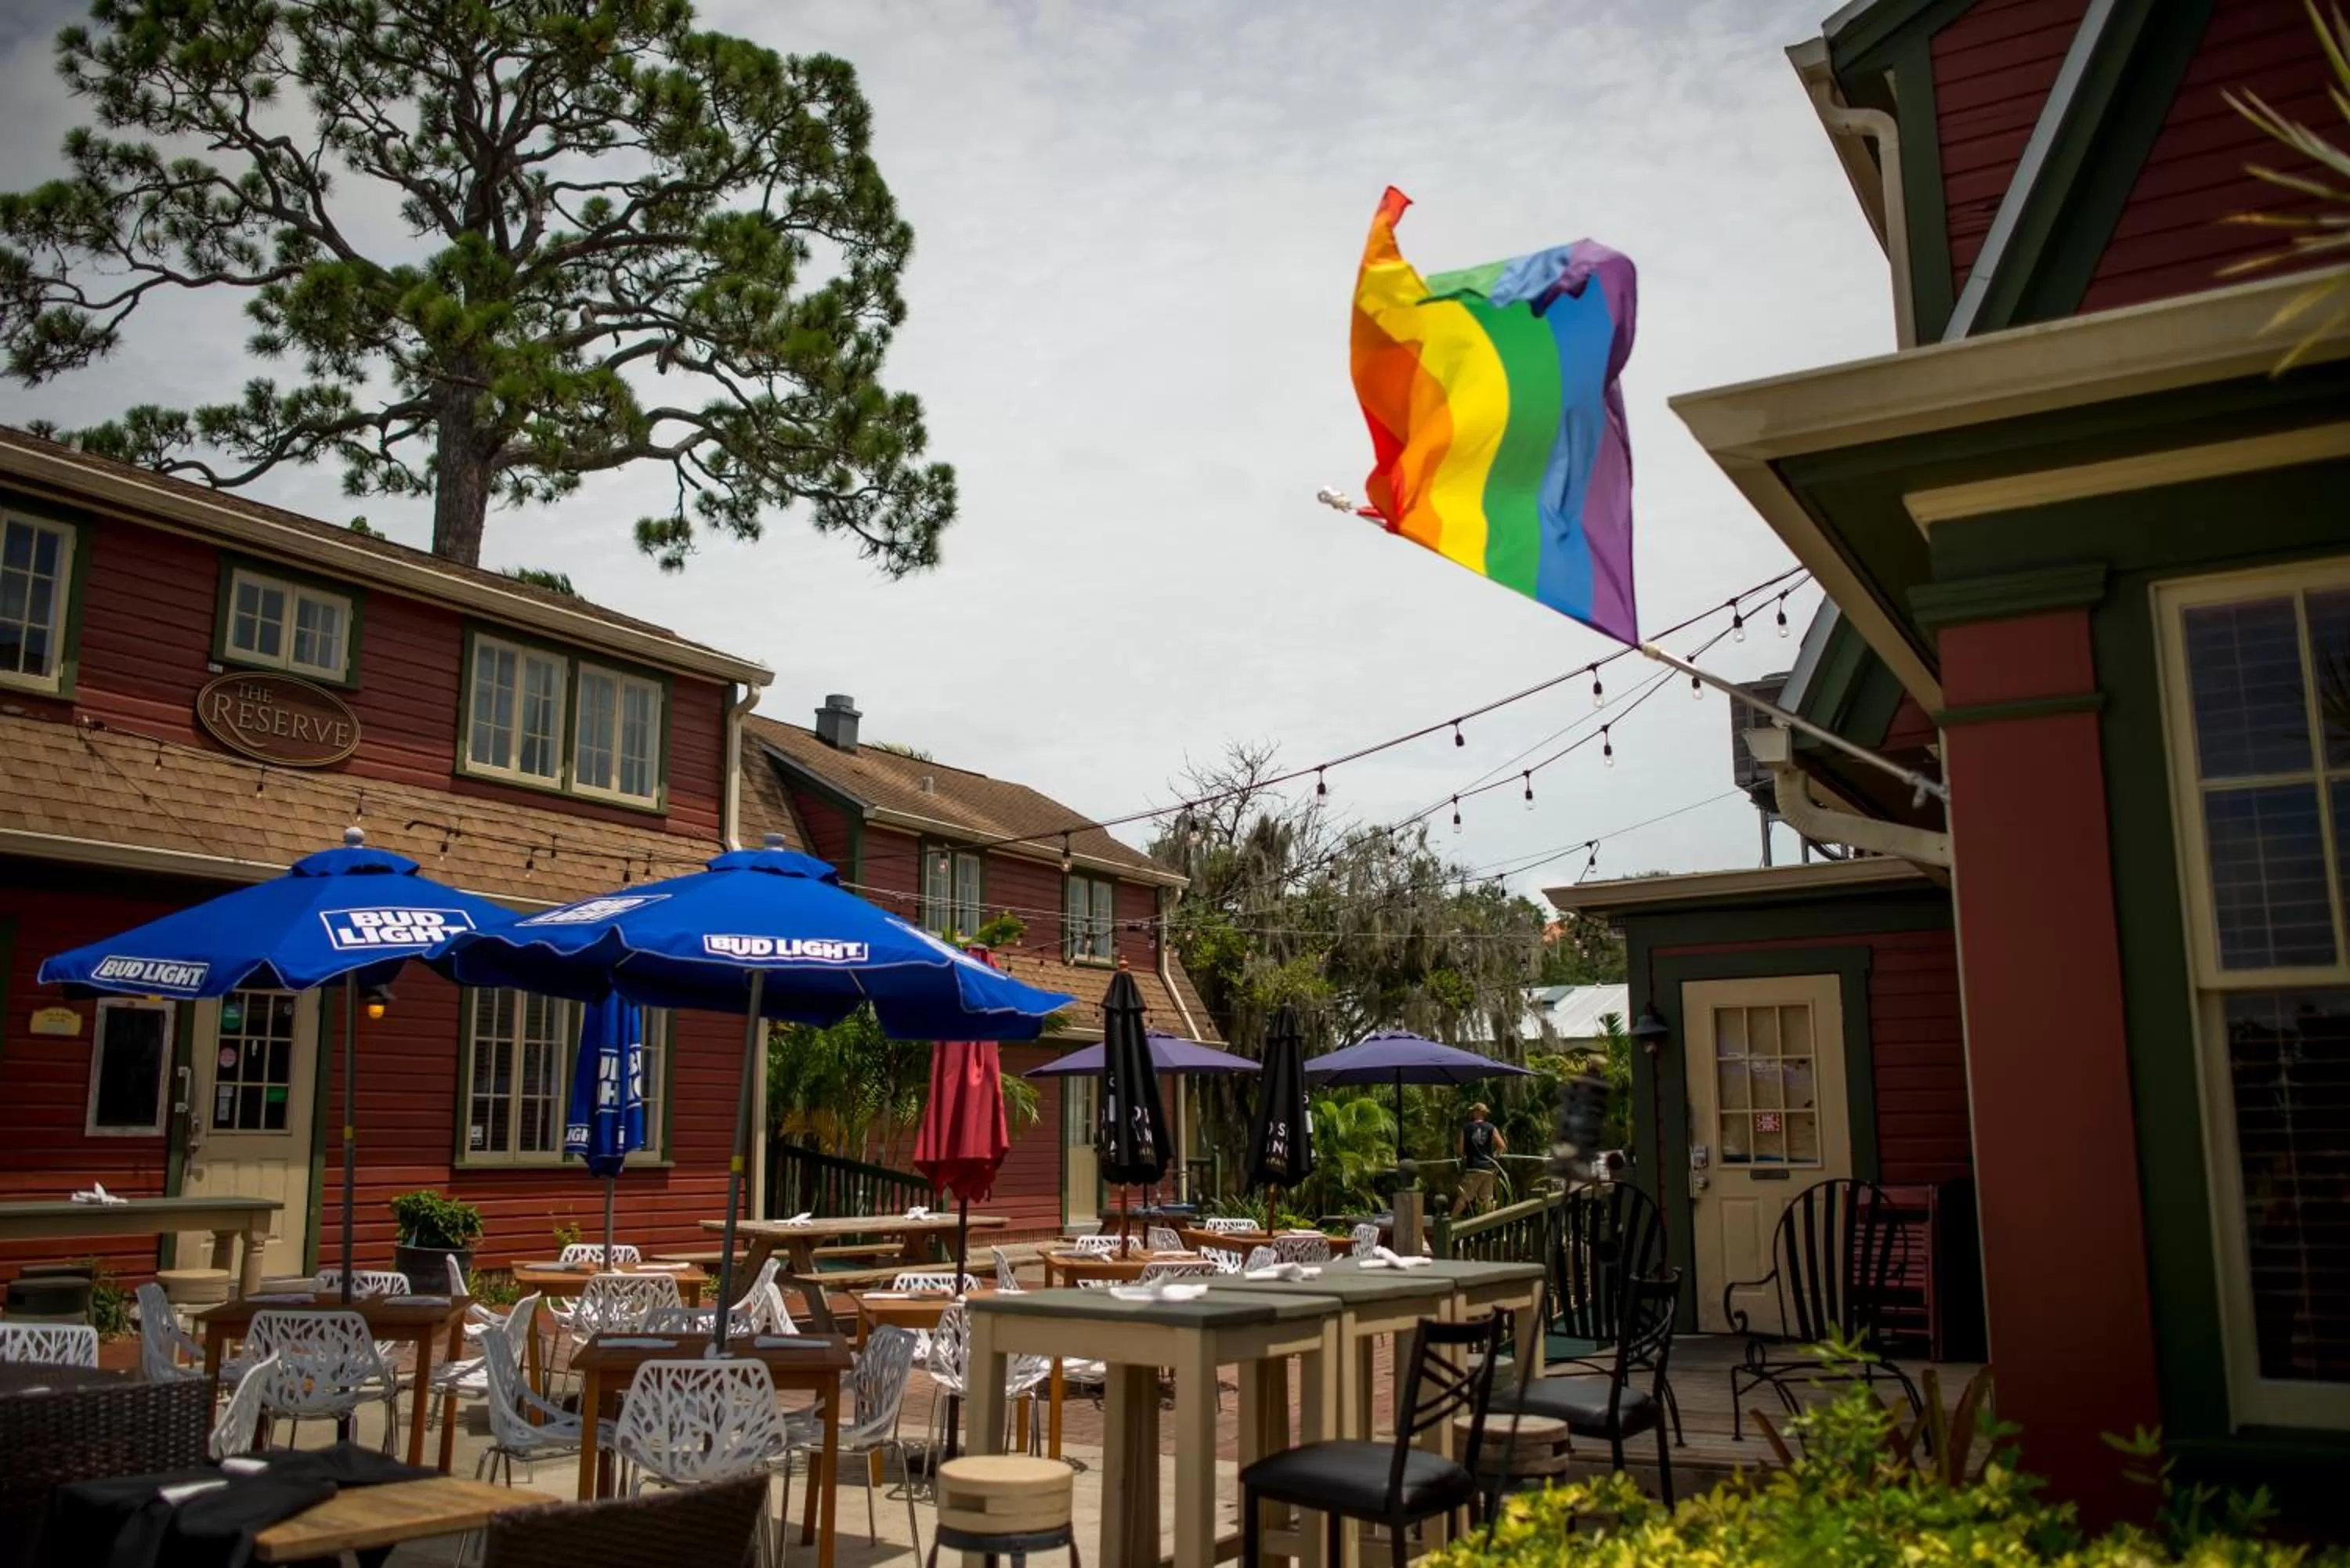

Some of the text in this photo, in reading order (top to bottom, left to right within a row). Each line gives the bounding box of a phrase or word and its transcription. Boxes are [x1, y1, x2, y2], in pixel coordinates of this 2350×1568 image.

[237, 682, 273, 703] THE
[211, 693, 349, 749] RESERVE
[349, 911, 446, 928] BUD
[710, 935, 861, 959] BUD LIGHT
[99, 959, 205, 986] BUD LIGHT
